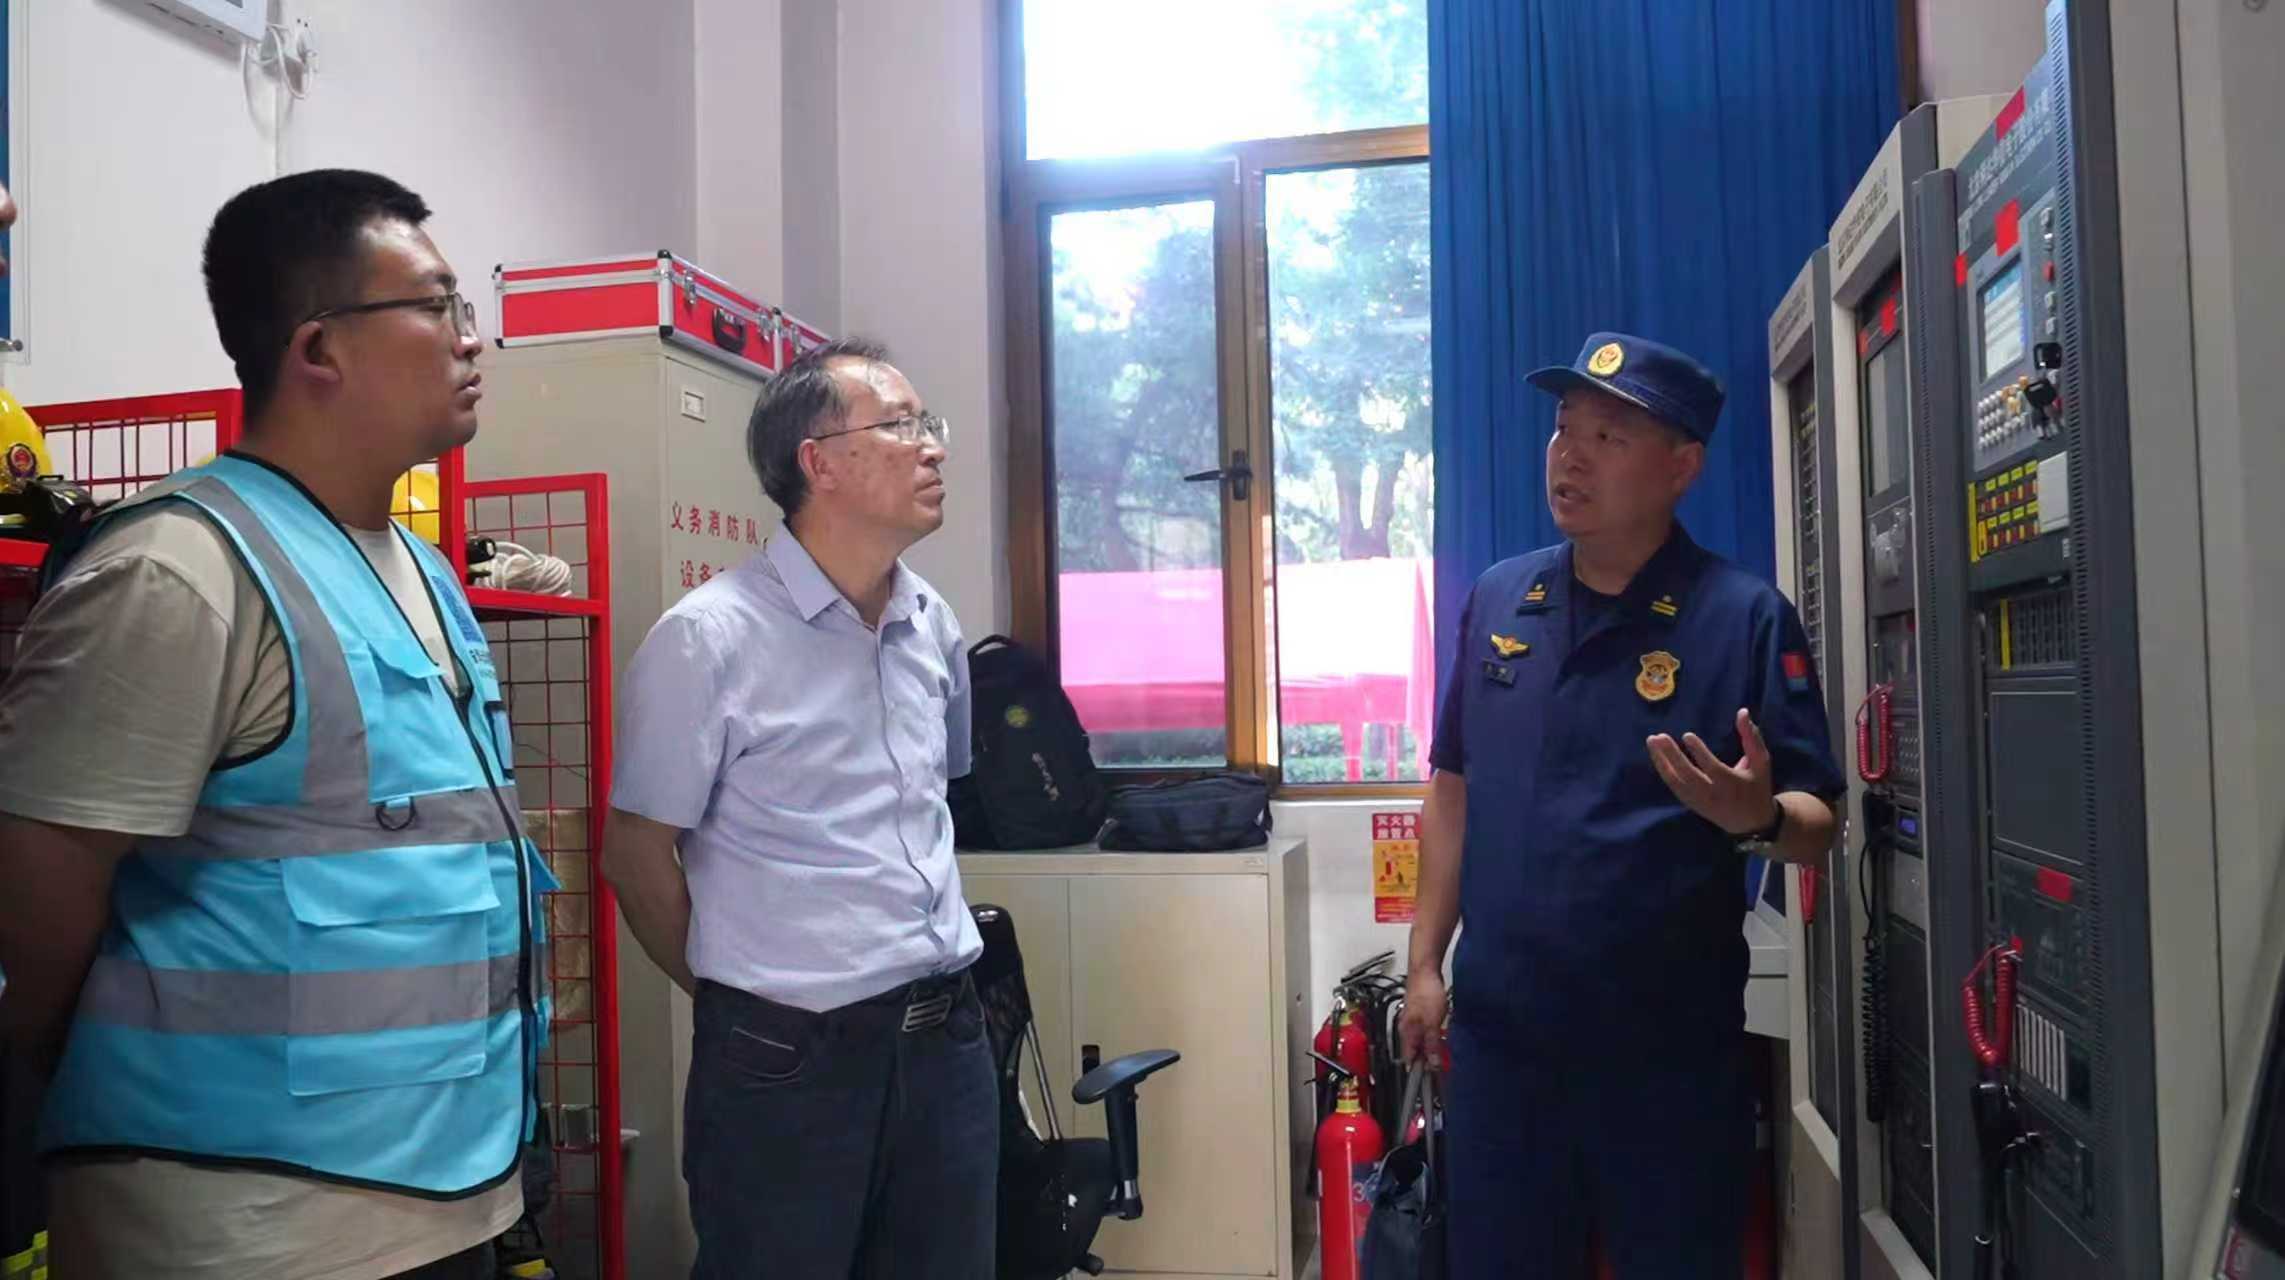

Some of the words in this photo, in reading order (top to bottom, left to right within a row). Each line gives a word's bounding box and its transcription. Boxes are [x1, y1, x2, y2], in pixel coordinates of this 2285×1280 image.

[671, 501, 768, 551] 义务消防队
[680, 560, 725, 588] 设备
